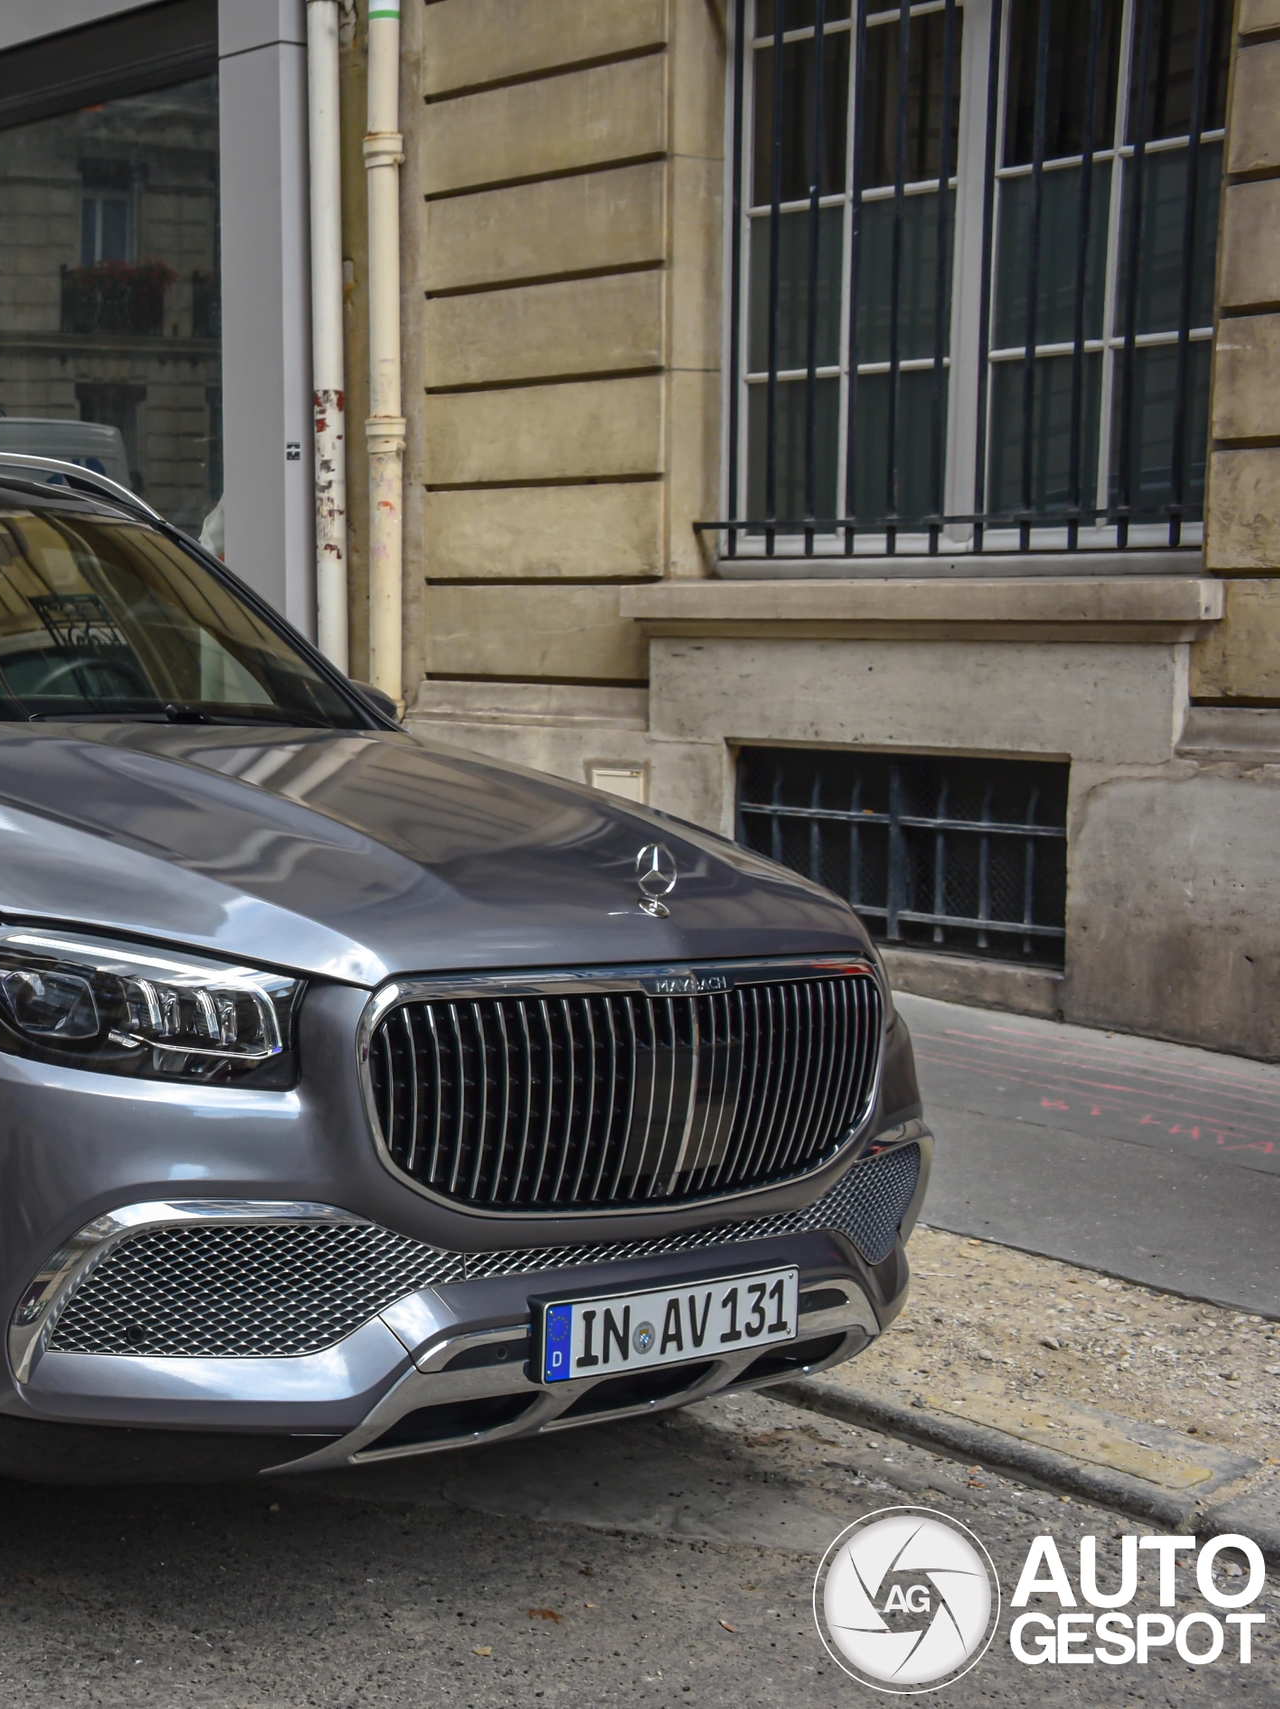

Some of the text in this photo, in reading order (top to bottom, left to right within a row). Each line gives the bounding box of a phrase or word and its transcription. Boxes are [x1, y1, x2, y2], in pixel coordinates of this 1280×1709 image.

[655, 976, 727, 993] MAYBACH
[575, 1278, 789, 1368] IN AV 131
[551, 1350, 563, 1368] D
